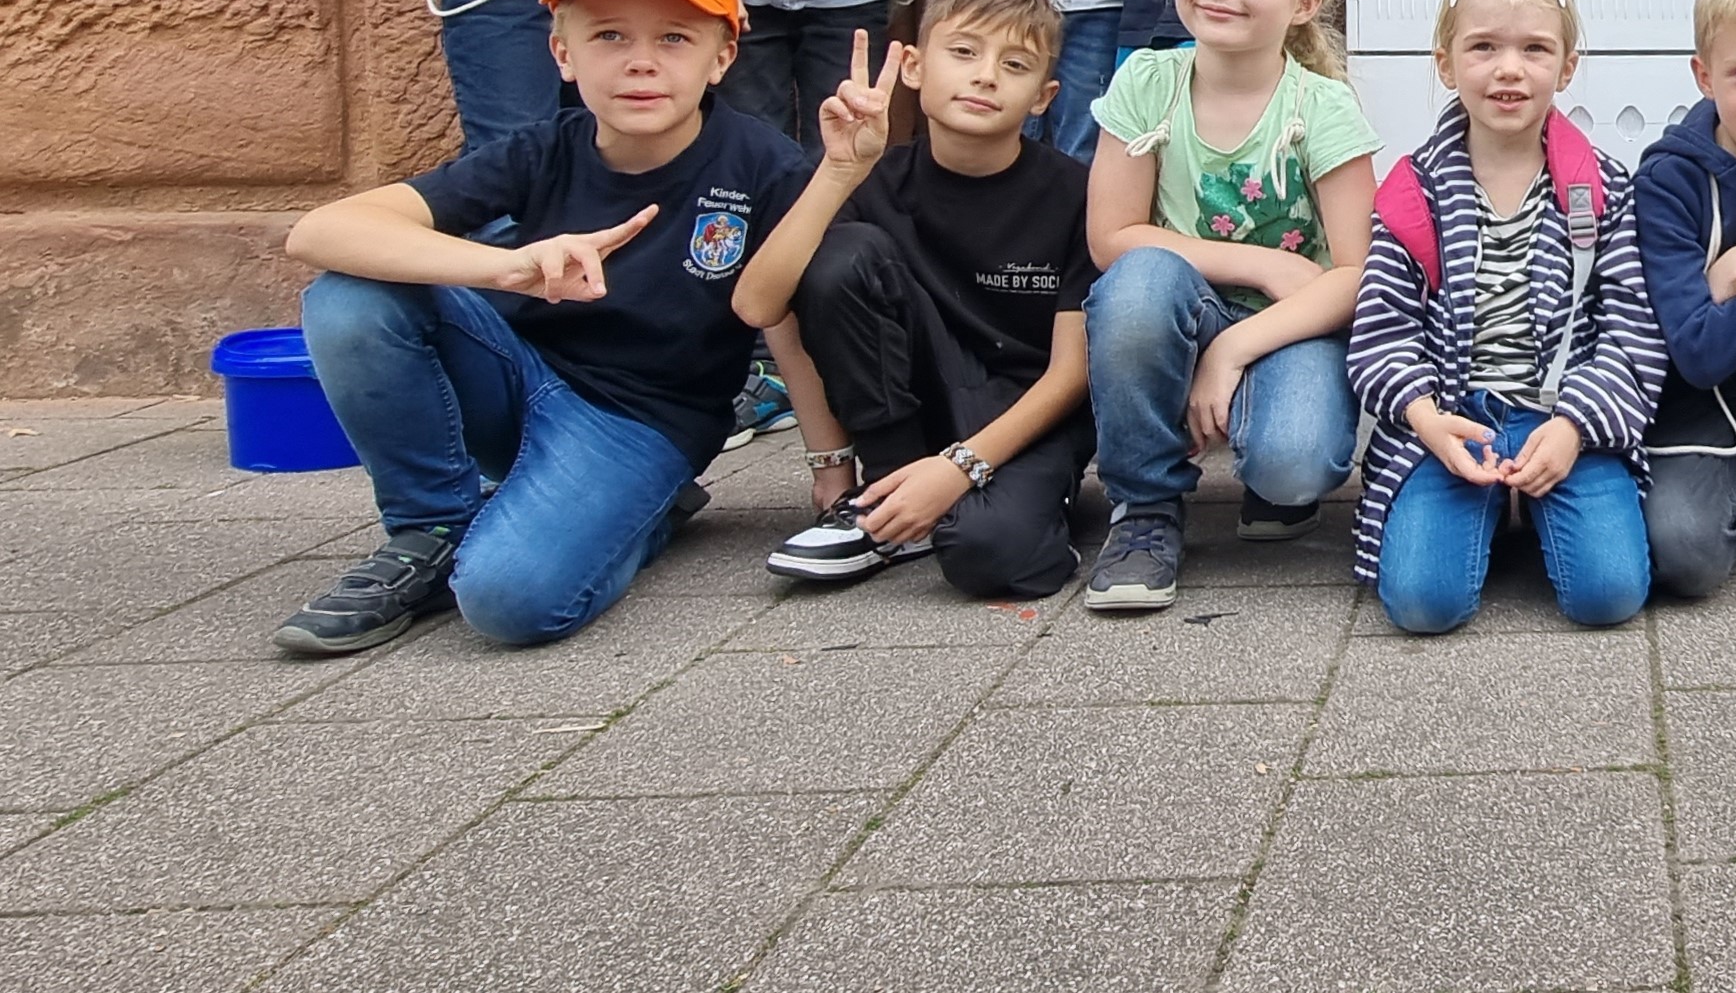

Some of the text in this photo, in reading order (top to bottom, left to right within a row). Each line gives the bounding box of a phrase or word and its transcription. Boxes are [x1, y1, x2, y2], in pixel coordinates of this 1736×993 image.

[710, 186, 751, 202] Kinder-
[976, 272, 1009, 288] MADE
[1012, 275, 1028, 288] BY
